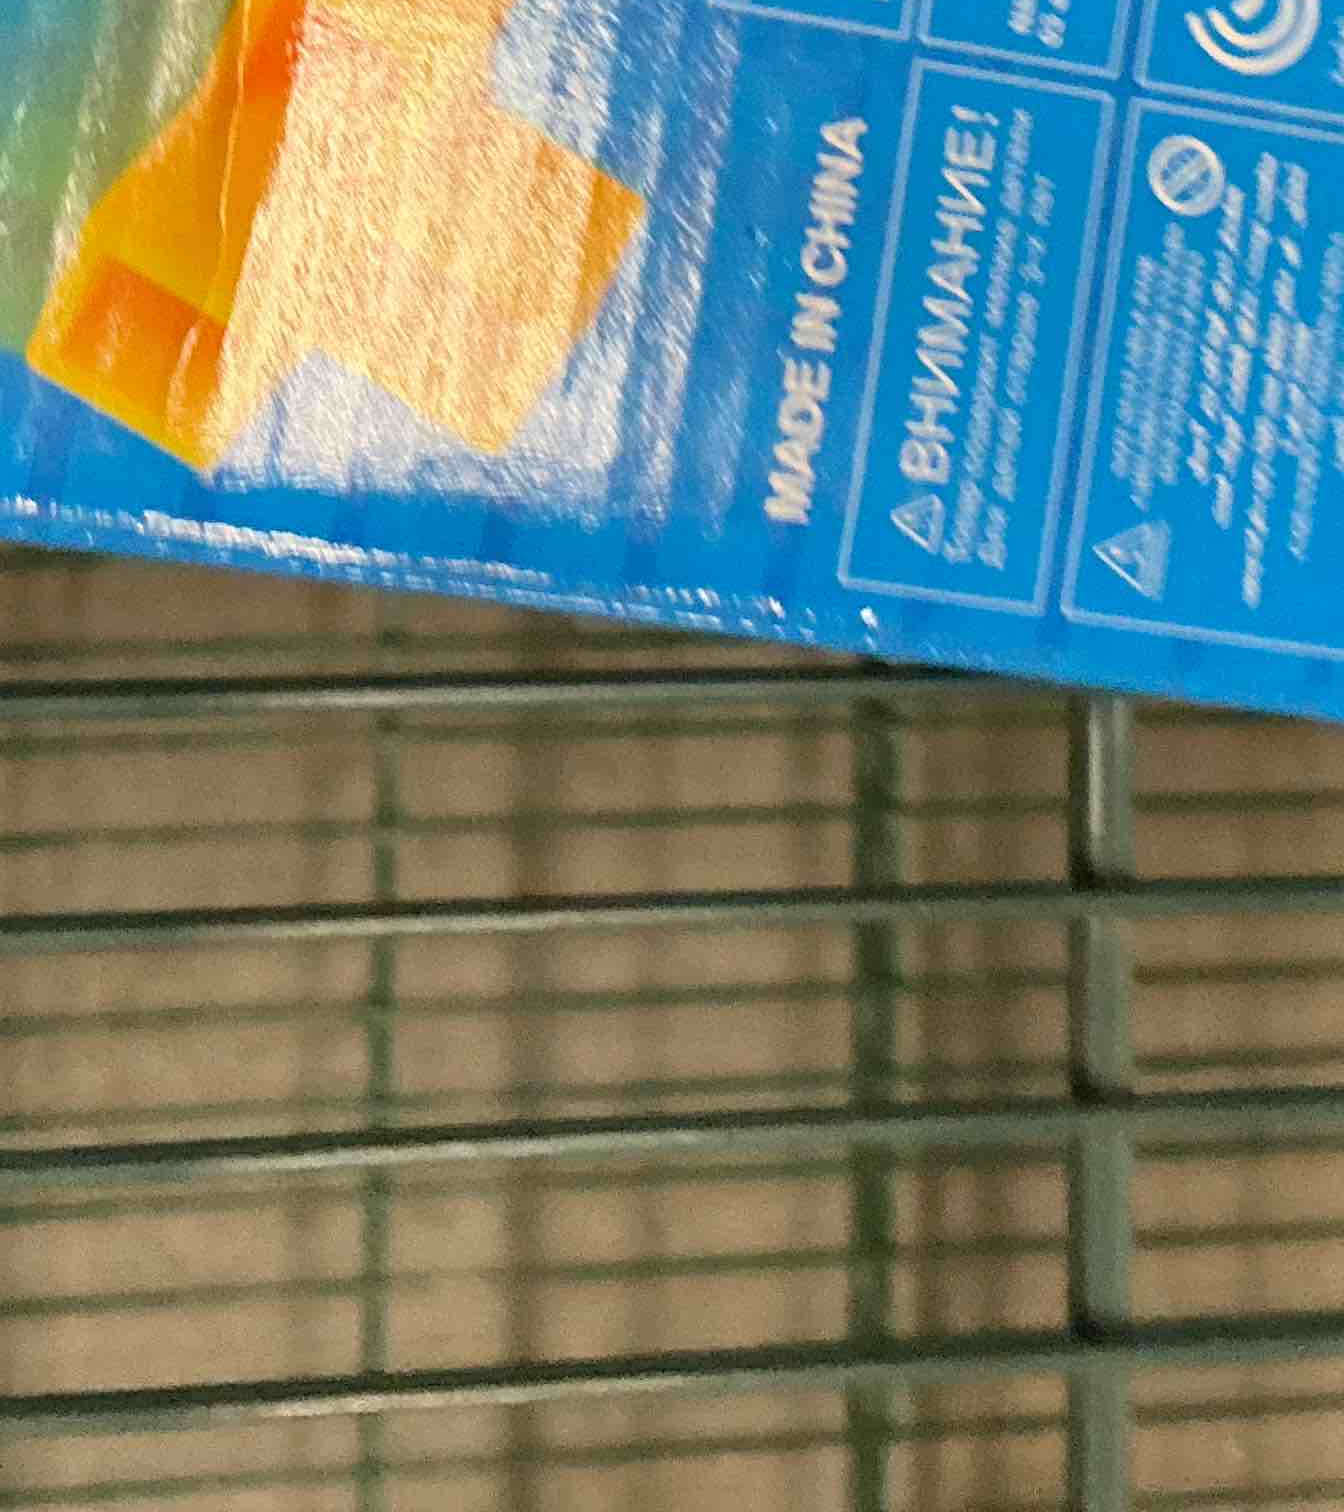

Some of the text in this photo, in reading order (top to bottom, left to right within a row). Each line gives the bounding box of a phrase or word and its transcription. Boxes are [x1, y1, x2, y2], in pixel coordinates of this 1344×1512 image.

[764, 117, 867, 523] MADE IN CHINA
[899, 106, 996, 483] ВНИМАНИЕ!
